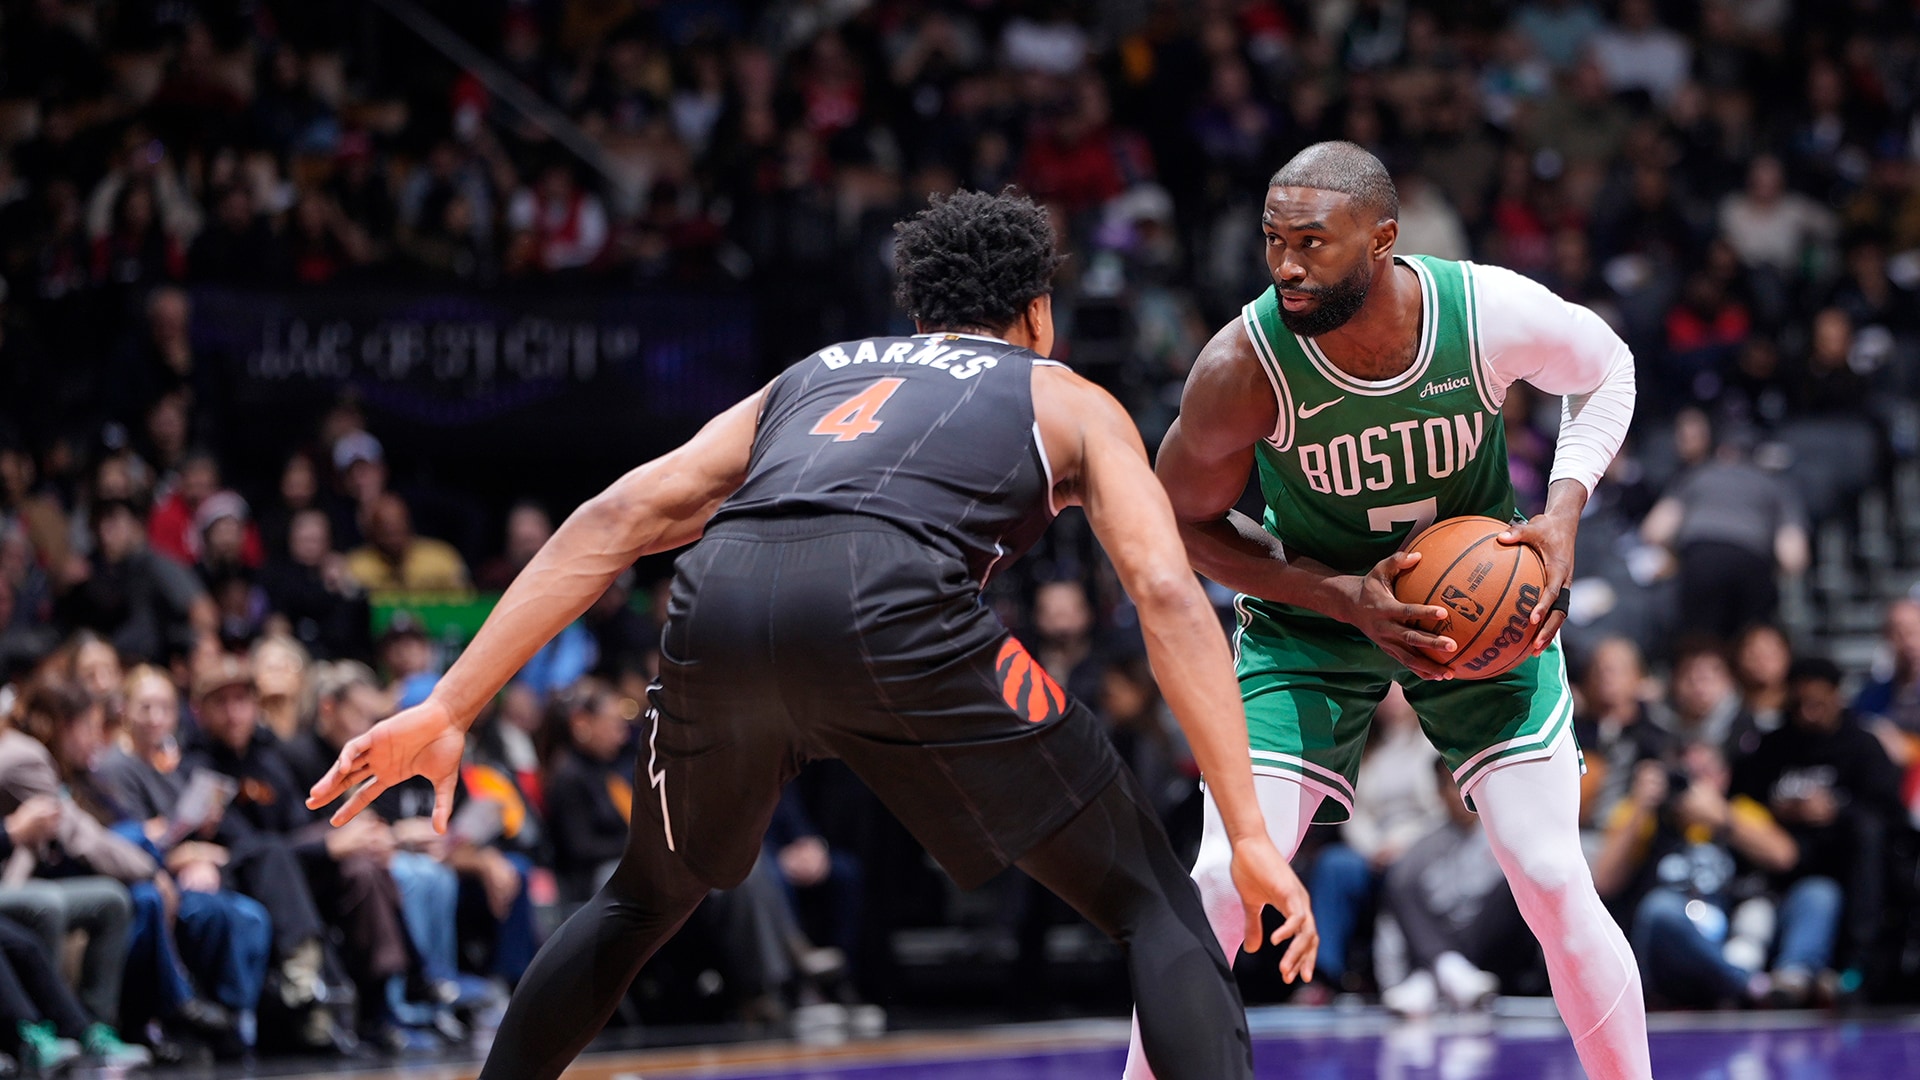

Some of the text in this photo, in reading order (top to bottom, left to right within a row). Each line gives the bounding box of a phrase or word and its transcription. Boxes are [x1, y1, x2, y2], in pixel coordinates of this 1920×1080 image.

[818, 341, 998, 380] BARNES
[1419, 376, 1471, 398] Amica
[808, 377, 908, 442] 4
[1297, 411, 1483, 497] BOSTON
[1366, 496, 1438, 552] 7
[1463, 582, 1541, 671] Wilson
